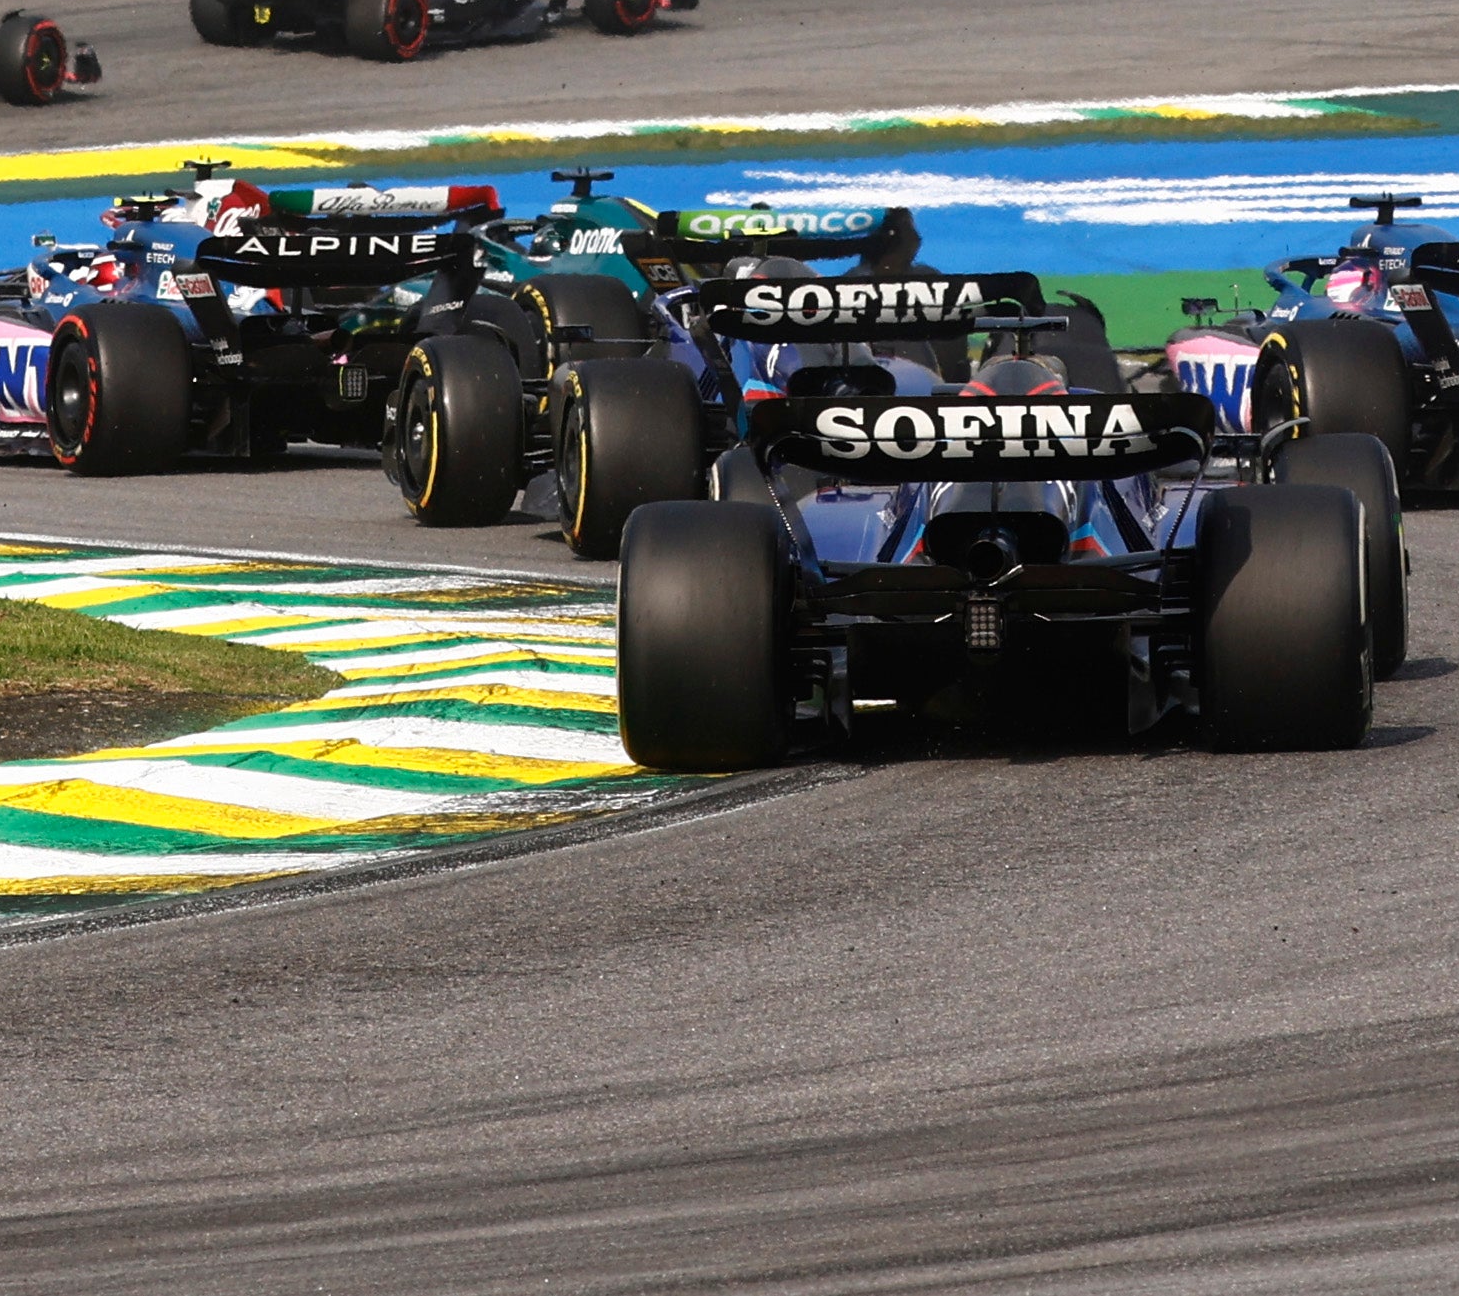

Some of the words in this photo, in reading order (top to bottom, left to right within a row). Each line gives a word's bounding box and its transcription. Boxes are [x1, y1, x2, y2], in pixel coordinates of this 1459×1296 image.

[318, 196, 364, 212] Alfa
[236, 234, 437, 256] ALPINE
[742, 282, 987, 326] SOFINA
[815, 405, 1159, 459] SOFINA
